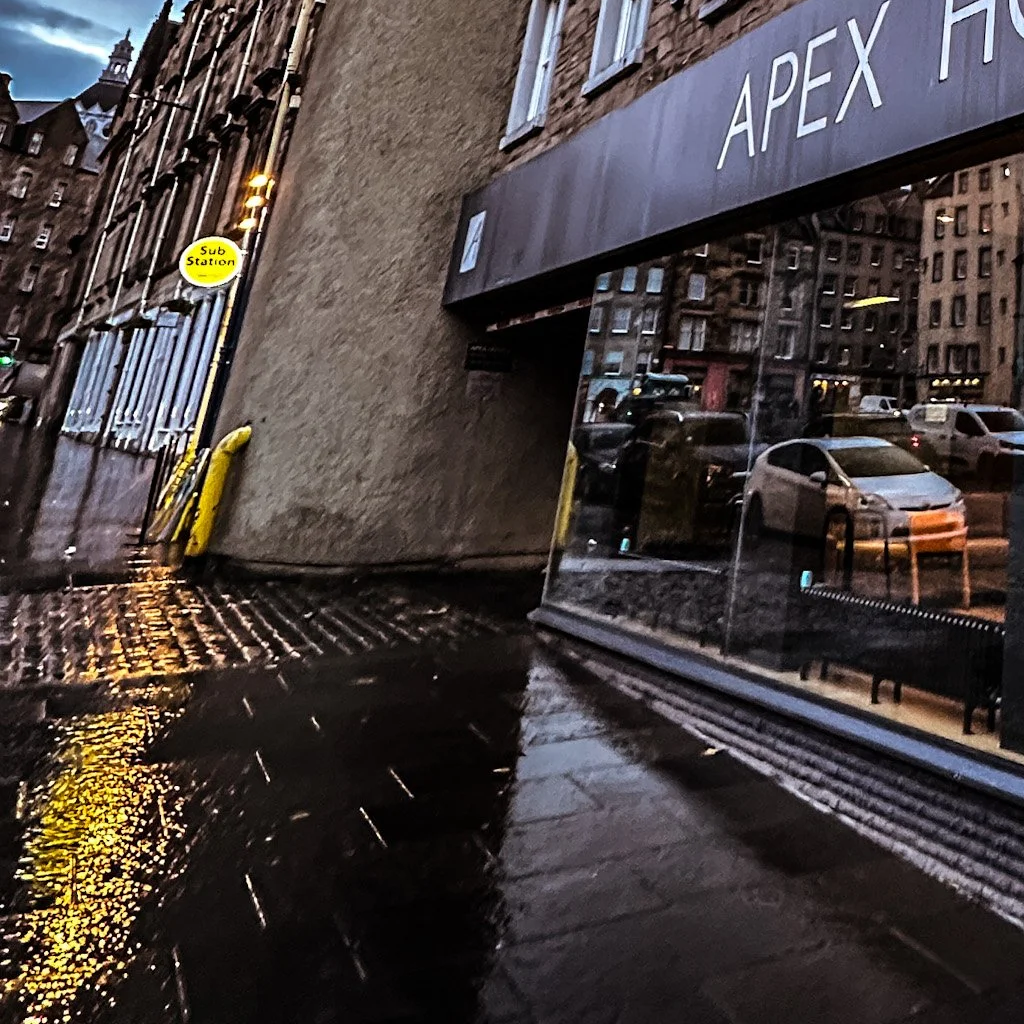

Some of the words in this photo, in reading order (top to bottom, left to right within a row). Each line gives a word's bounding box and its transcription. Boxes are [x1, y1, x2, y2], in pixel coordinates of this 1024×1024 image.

[717, 0, 892, 170] APEX
[200, 245, 226, 256] Sub
[186, 256, 235, 266] Station
